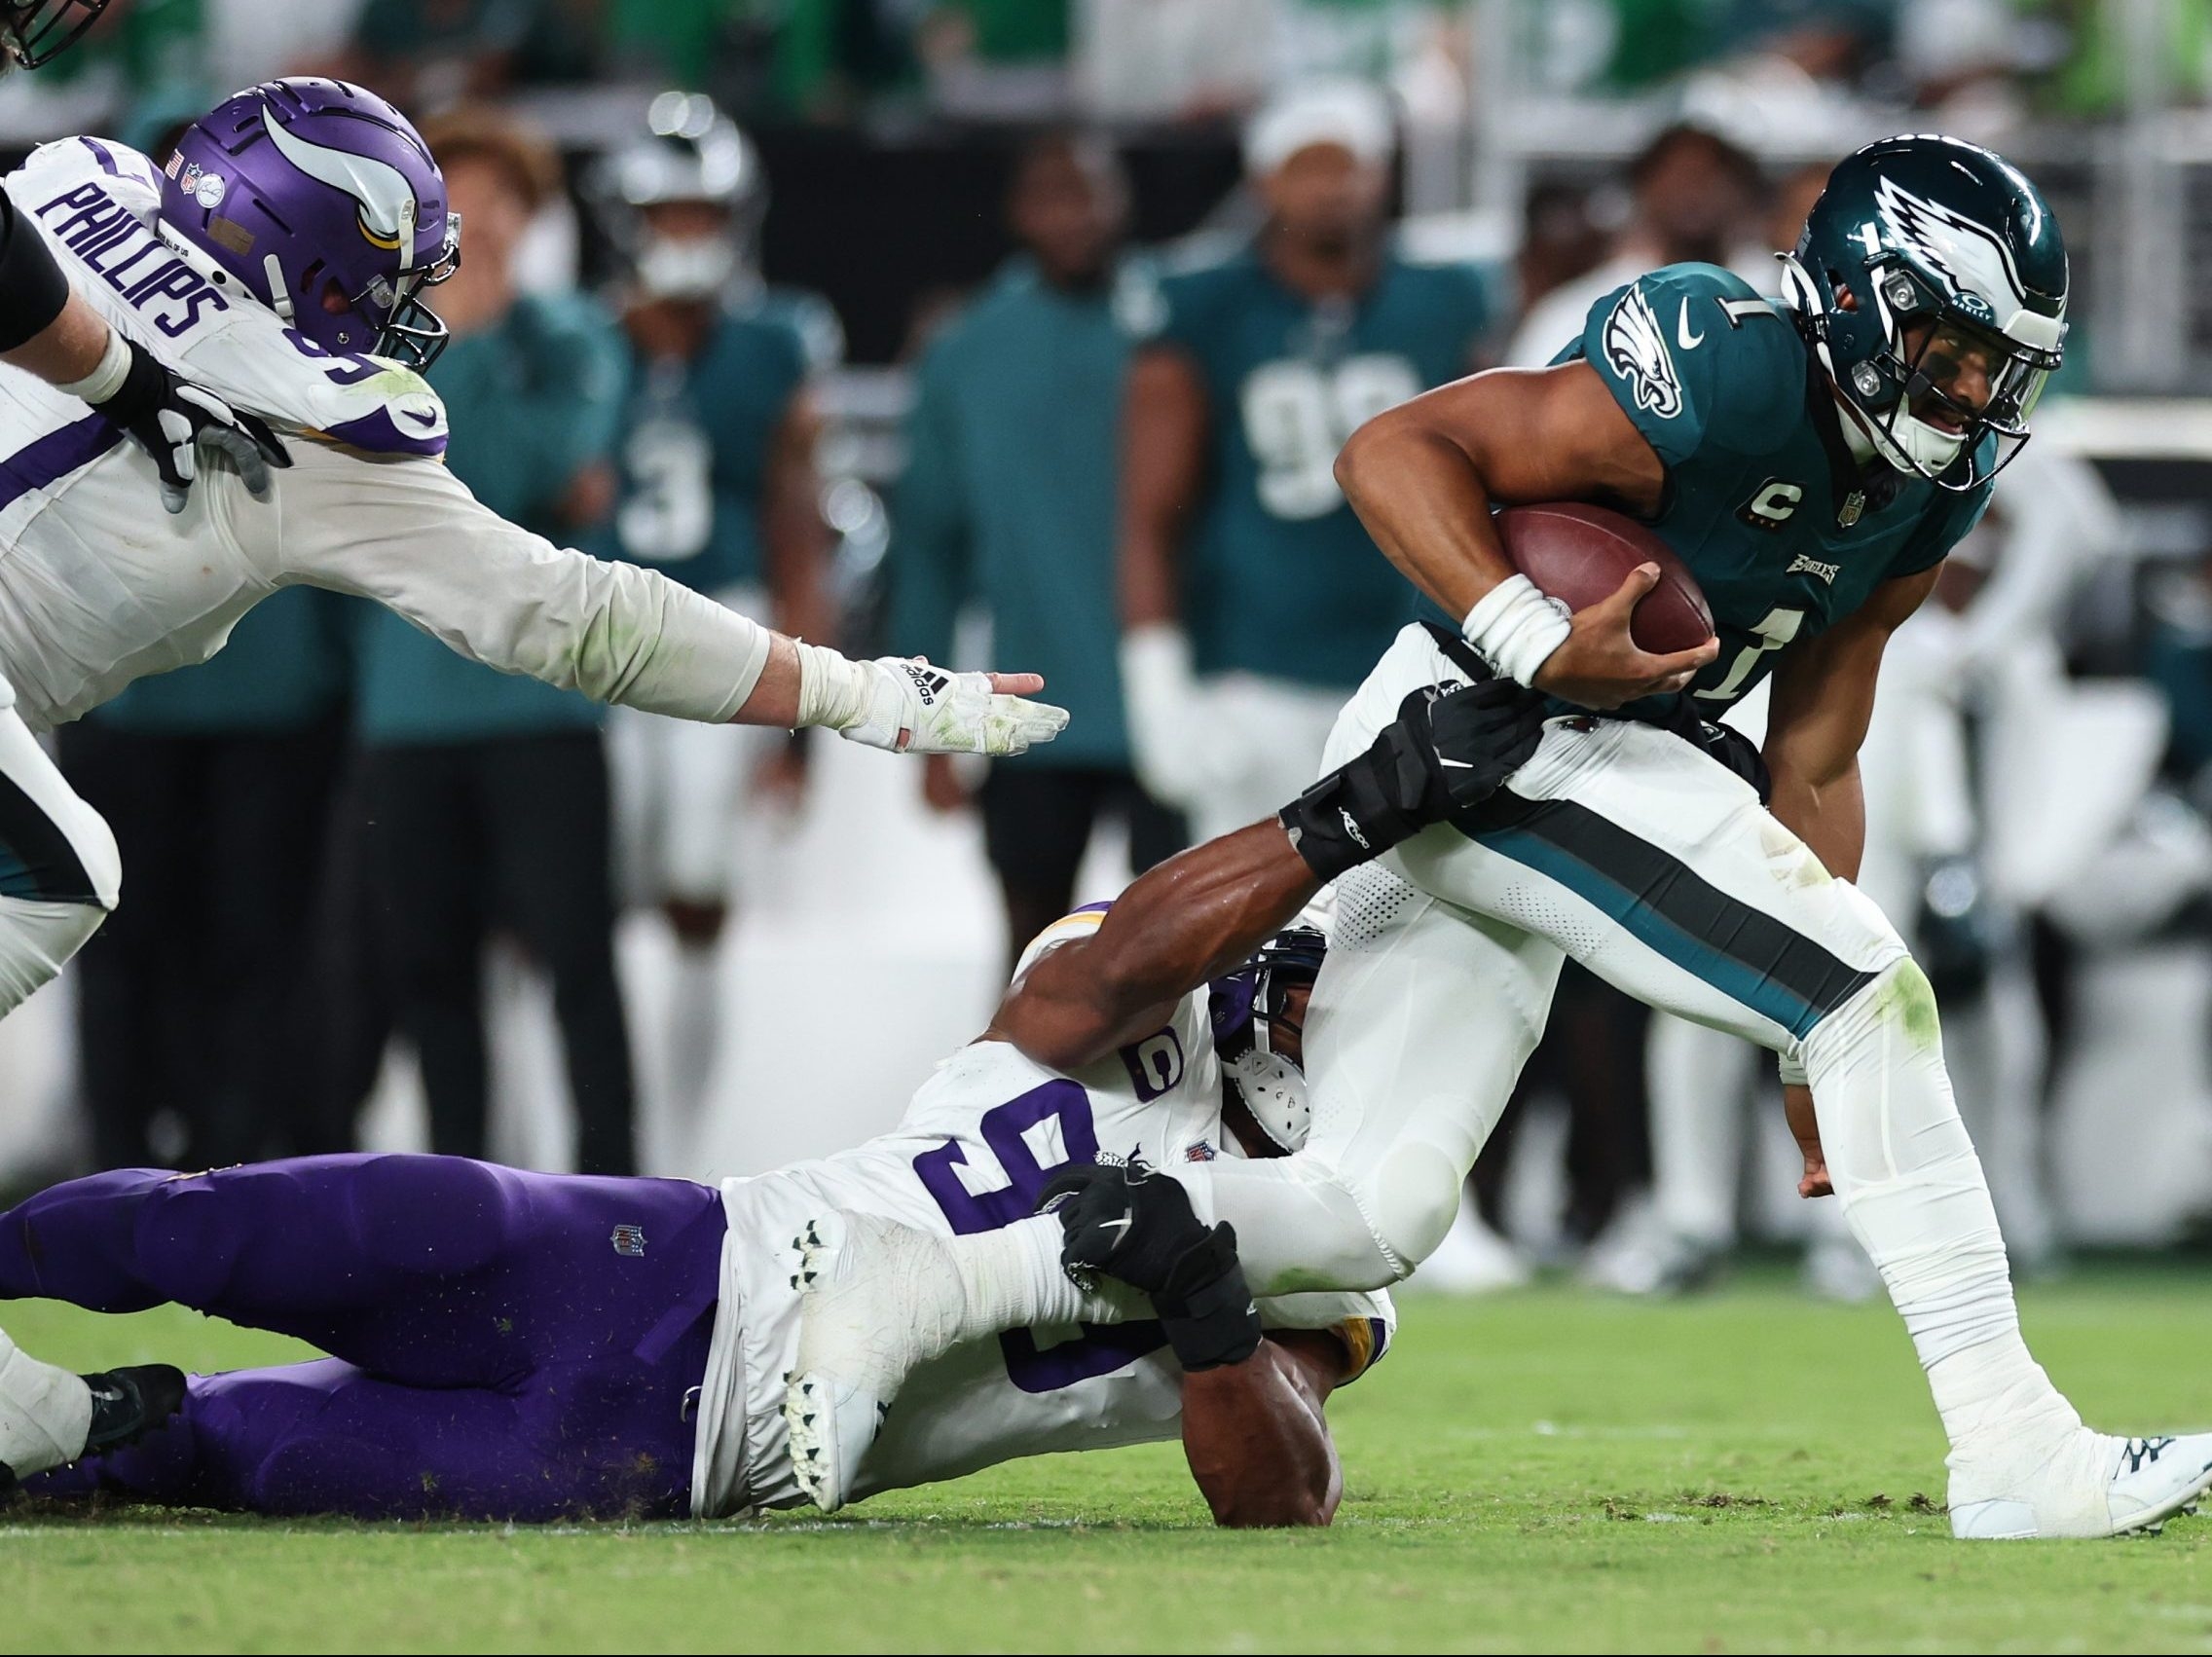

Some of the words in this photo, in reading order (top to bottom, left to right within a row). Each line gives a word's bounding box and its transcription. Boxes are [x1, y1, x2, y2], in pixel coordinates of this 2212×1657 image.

[34, 181, 229, 338] PHILLIPS
[1951, 298, 1992, 320] OAKLEY
[617, 419, 715, 562] 3
[1751, 483, 1802, 520] C
[900, 663, 935, 706] adidas
[1692, 608, 1805, 700] 1
